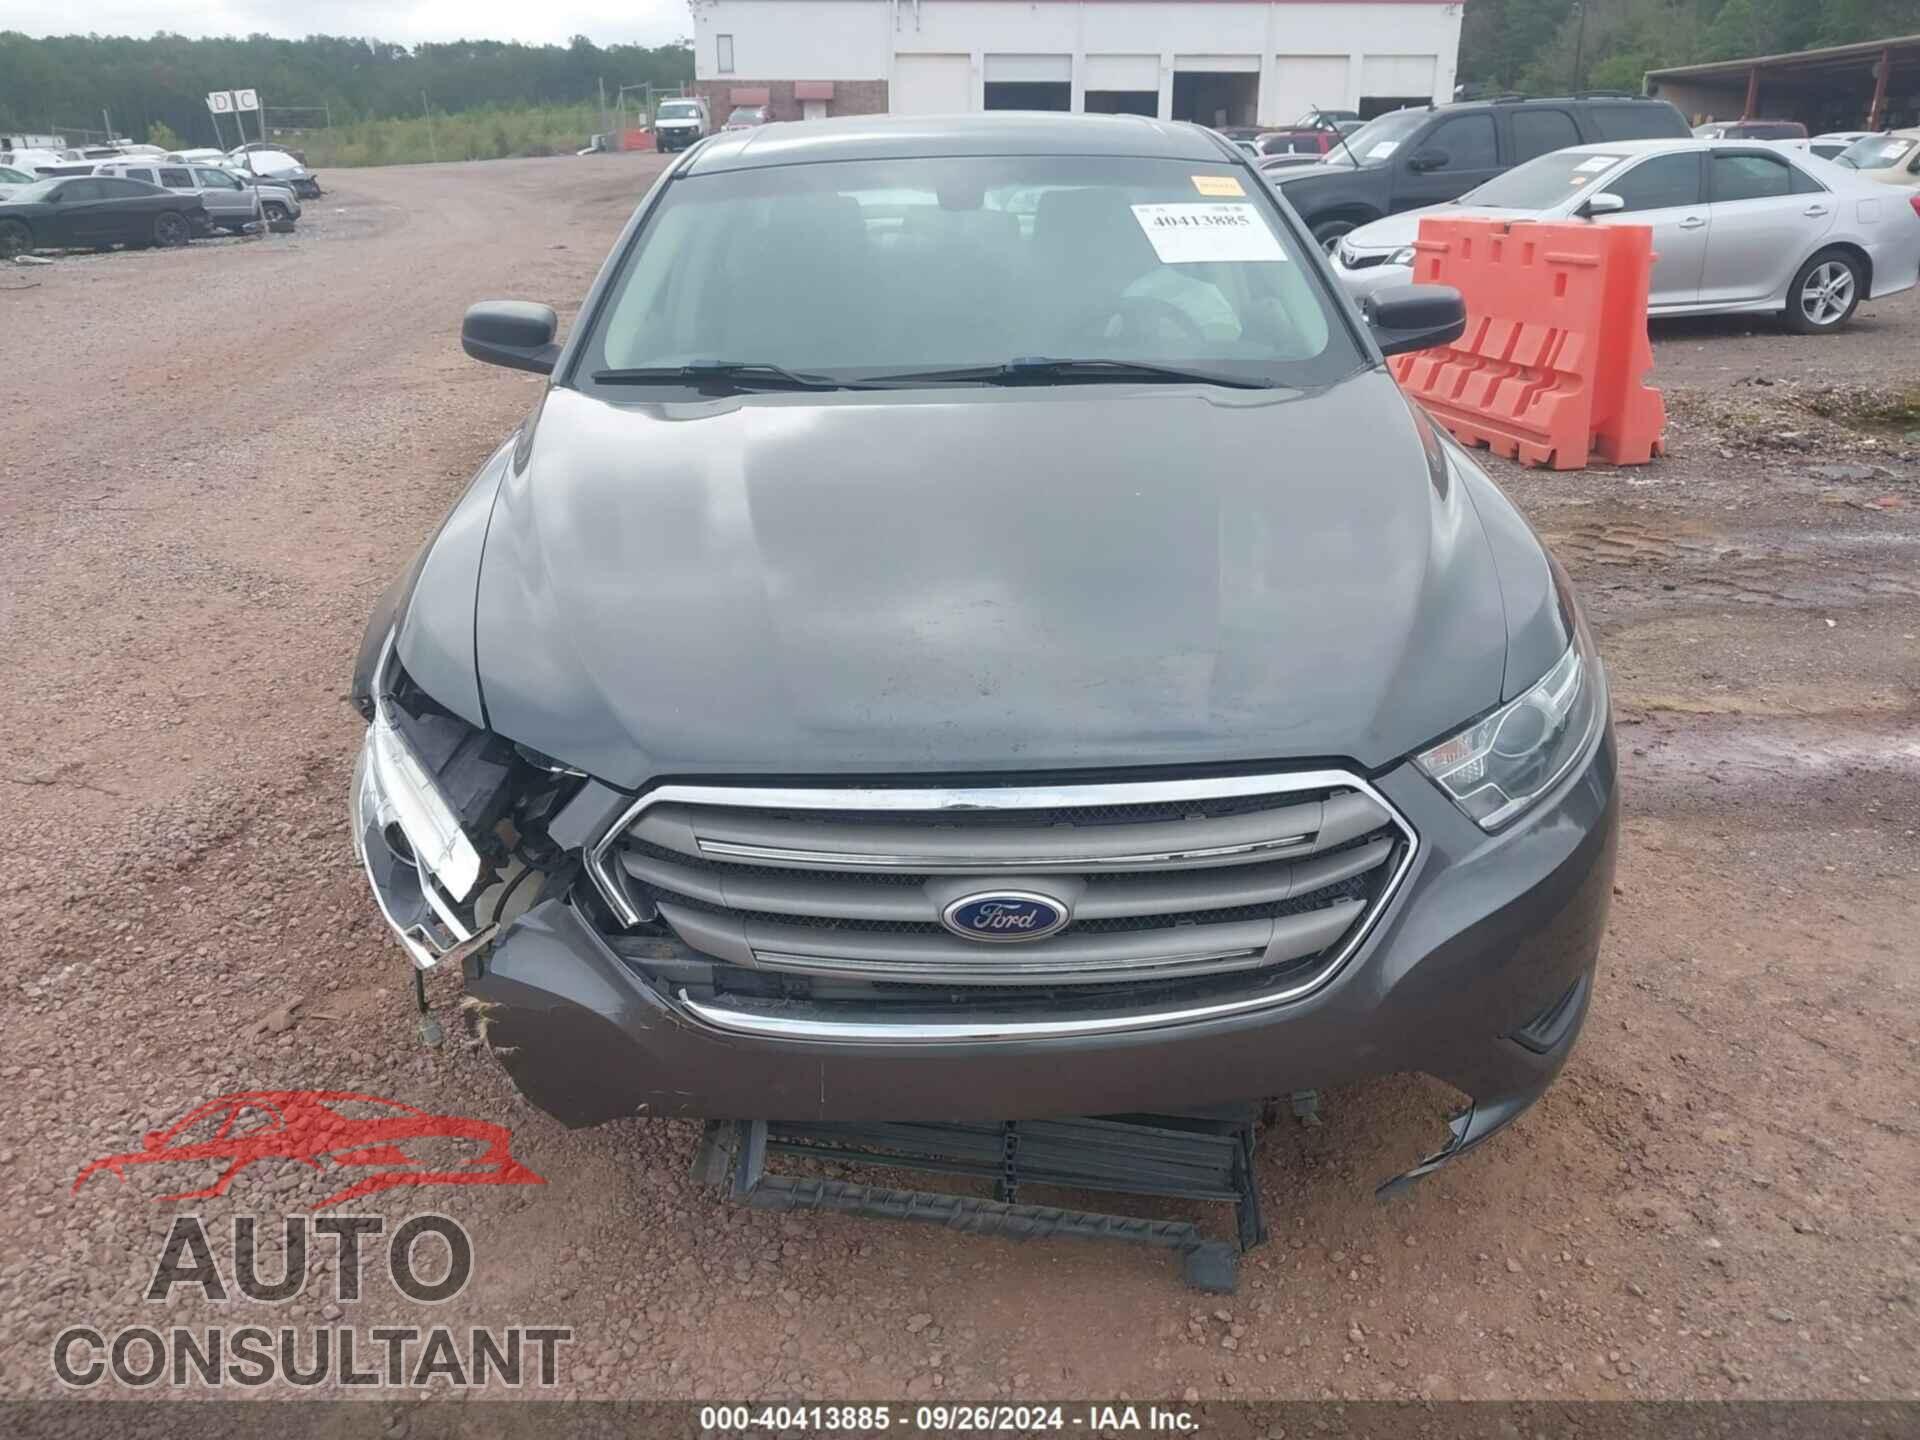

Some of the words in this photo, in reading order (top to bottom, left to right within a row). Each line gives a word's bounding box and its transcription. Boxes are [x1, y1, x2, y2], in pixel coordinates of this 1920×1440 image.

[214, 95, 227, 111] D
[241, 92, 254, 108] C
[1153, 215, 1250, 227] 40413885
[974, 903, 1037, 928] Ford
